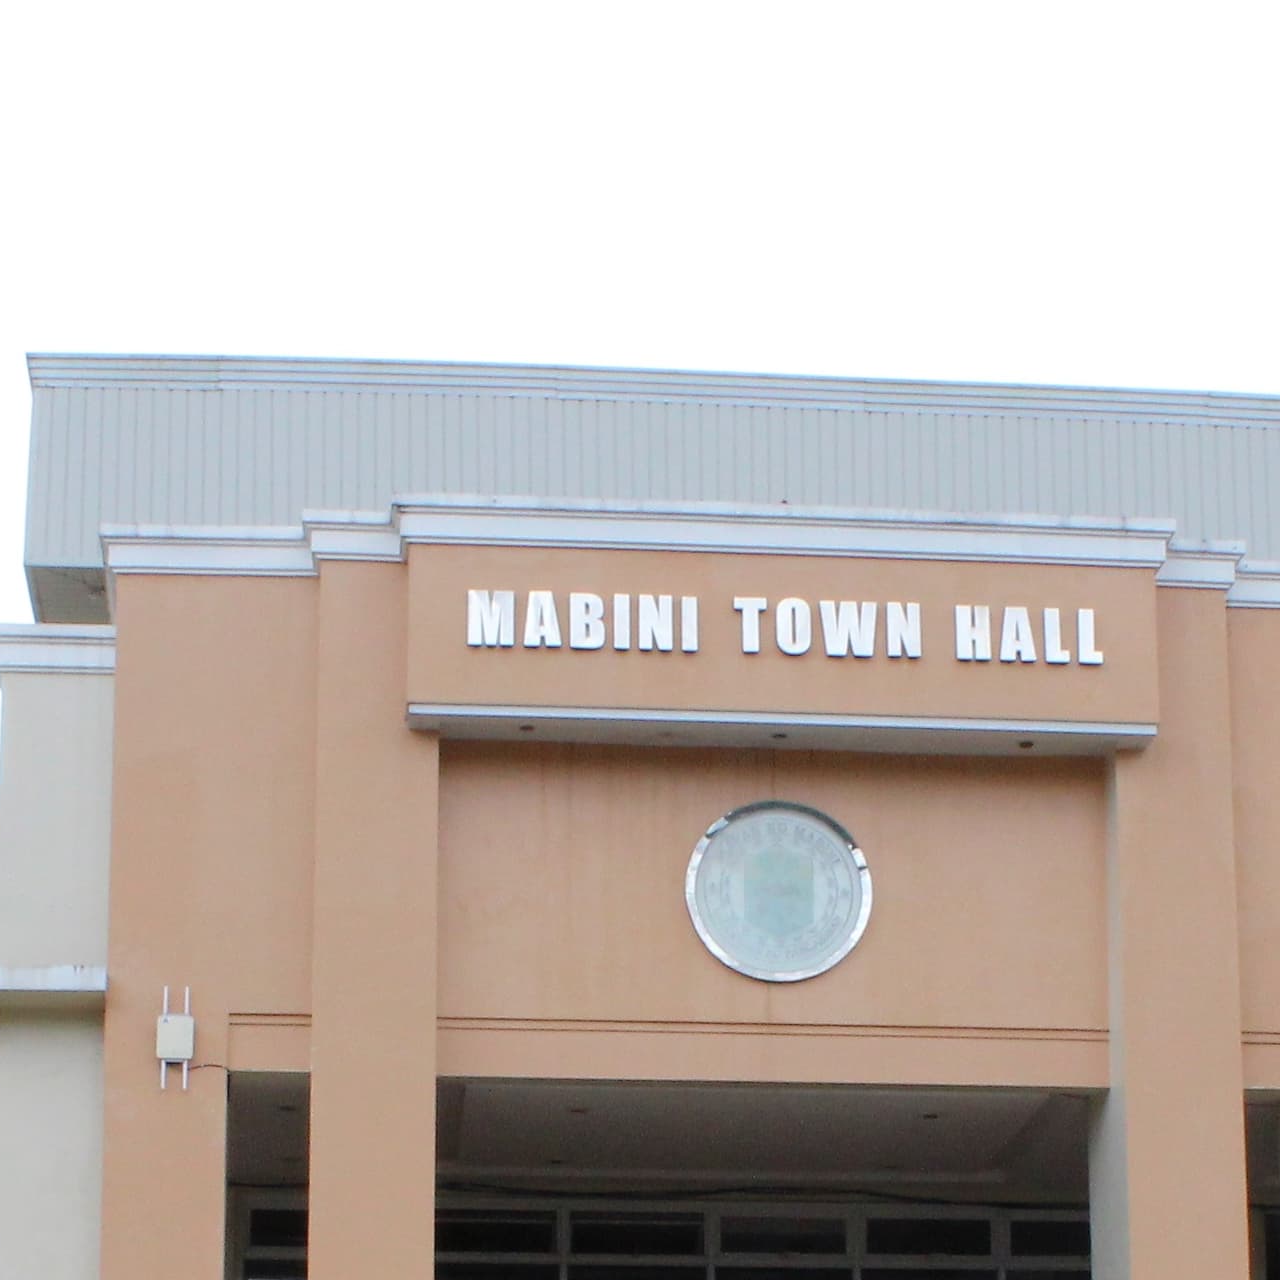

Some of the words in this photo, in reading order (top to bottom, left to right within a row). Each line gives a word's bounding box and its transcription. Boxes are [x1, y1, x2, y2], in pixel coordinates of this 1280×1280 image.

[466, 588, 700, 653] MABINI
[733, 596, 923, 659] TOWN
[954, 604, 1105, 666] HALL
